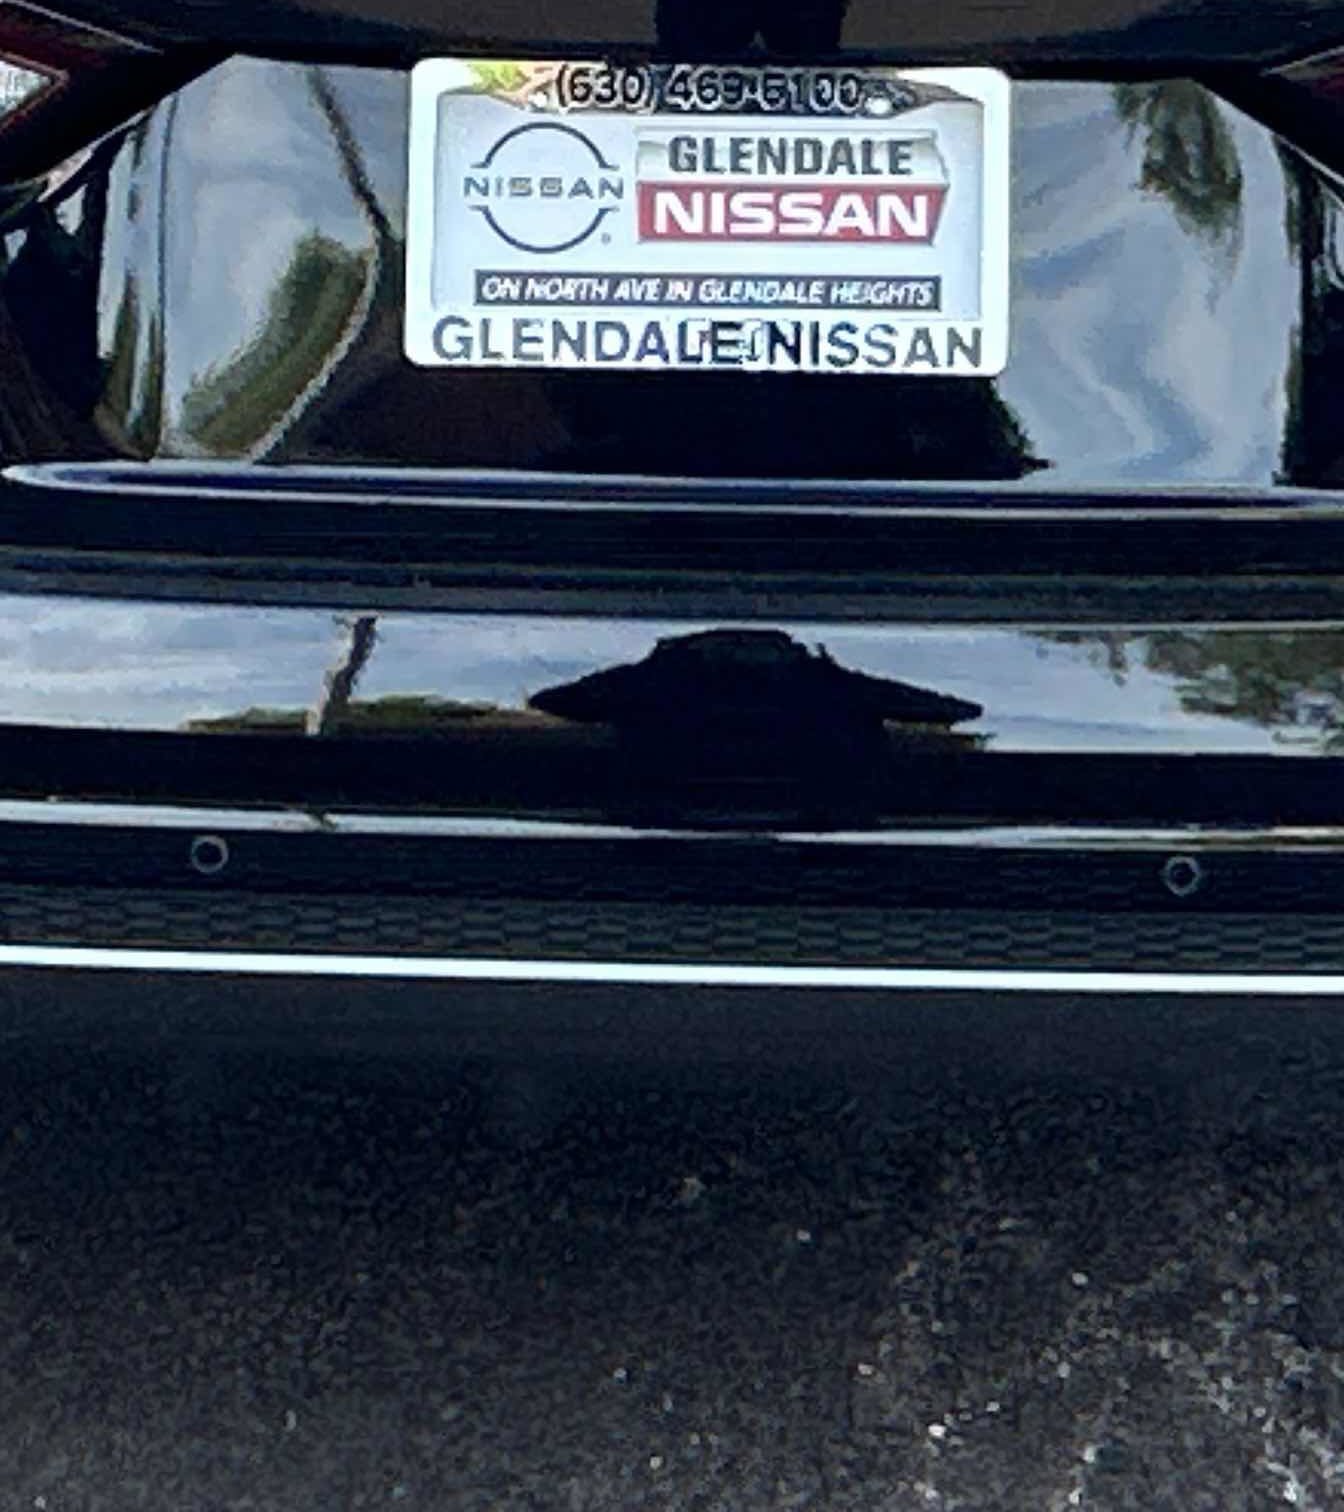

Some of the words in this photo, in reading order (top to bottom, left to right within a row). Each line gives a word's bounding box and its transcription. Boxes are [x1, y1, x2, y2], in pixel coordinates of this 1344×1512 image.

[556, 63, 654, 111] (630)
[668, 136, 913, 175] GLENDALE
[464, 177, 624, 199] NISSAN
[654, 191, 928, 236] NISSAN
[482, 276, 521, 299] ON
[524, 276, 609, 300] NORTH
[613, 276, 660, 301] AVE
[665, 278, 692, 302] IN
[698, 278, 824, 304] GLENDALE
[830, 280, 934, 305] HEIGHTS
[432, 314, 744, 364] GLENDALE
[767, 319, 982, 368] NISSAN
